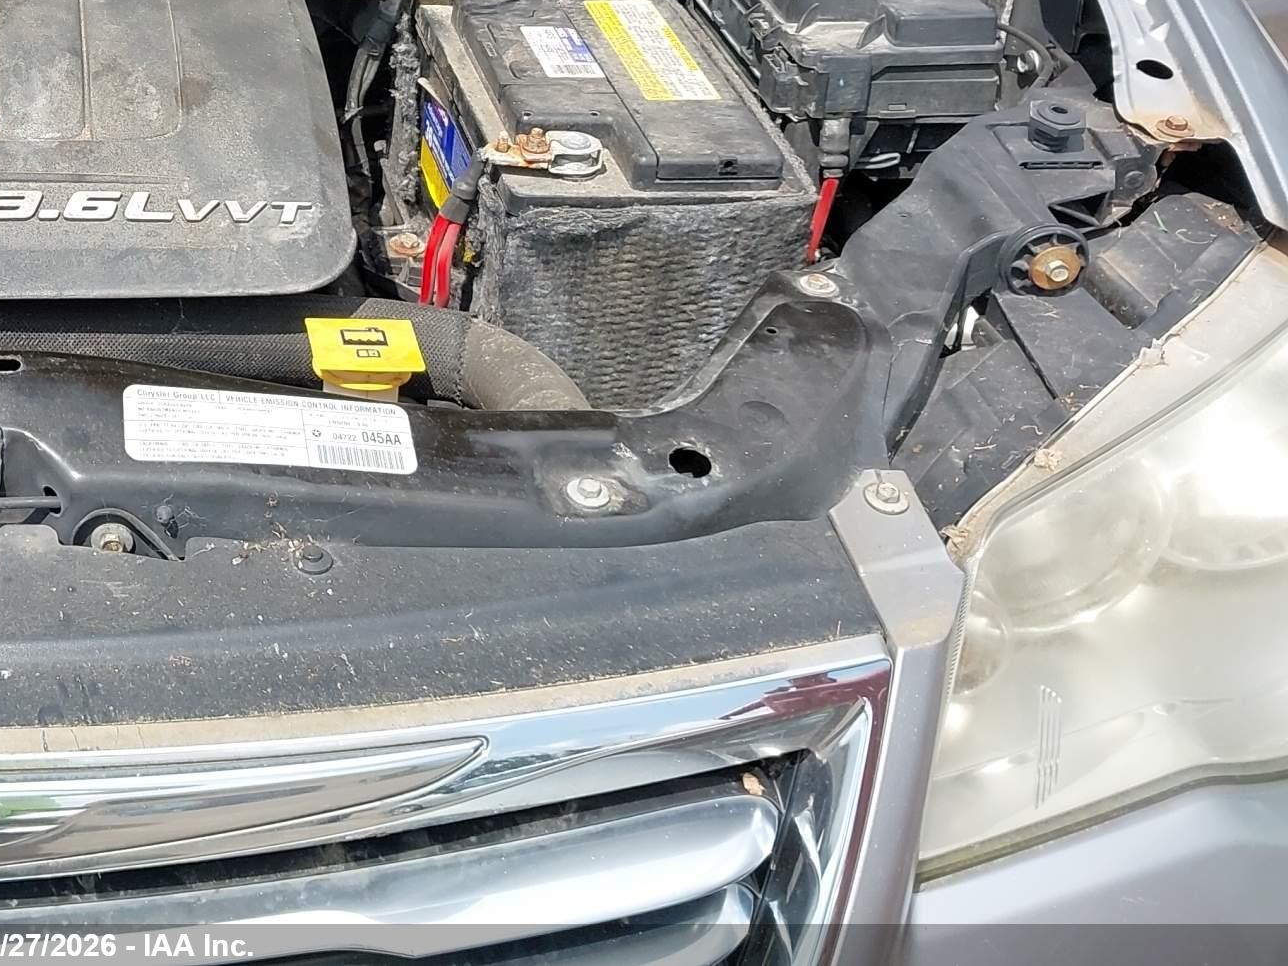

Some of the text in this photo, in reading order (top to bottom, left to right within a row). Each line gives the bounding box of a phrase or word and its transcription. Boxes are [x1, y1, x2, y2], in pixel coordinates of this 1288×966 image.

[137, 388, 396, 415] Chrysler Group LLC VEHICLE EMISSION CONTROL INFORMATION
[332, 431, 402, 445] 04722 045AA
